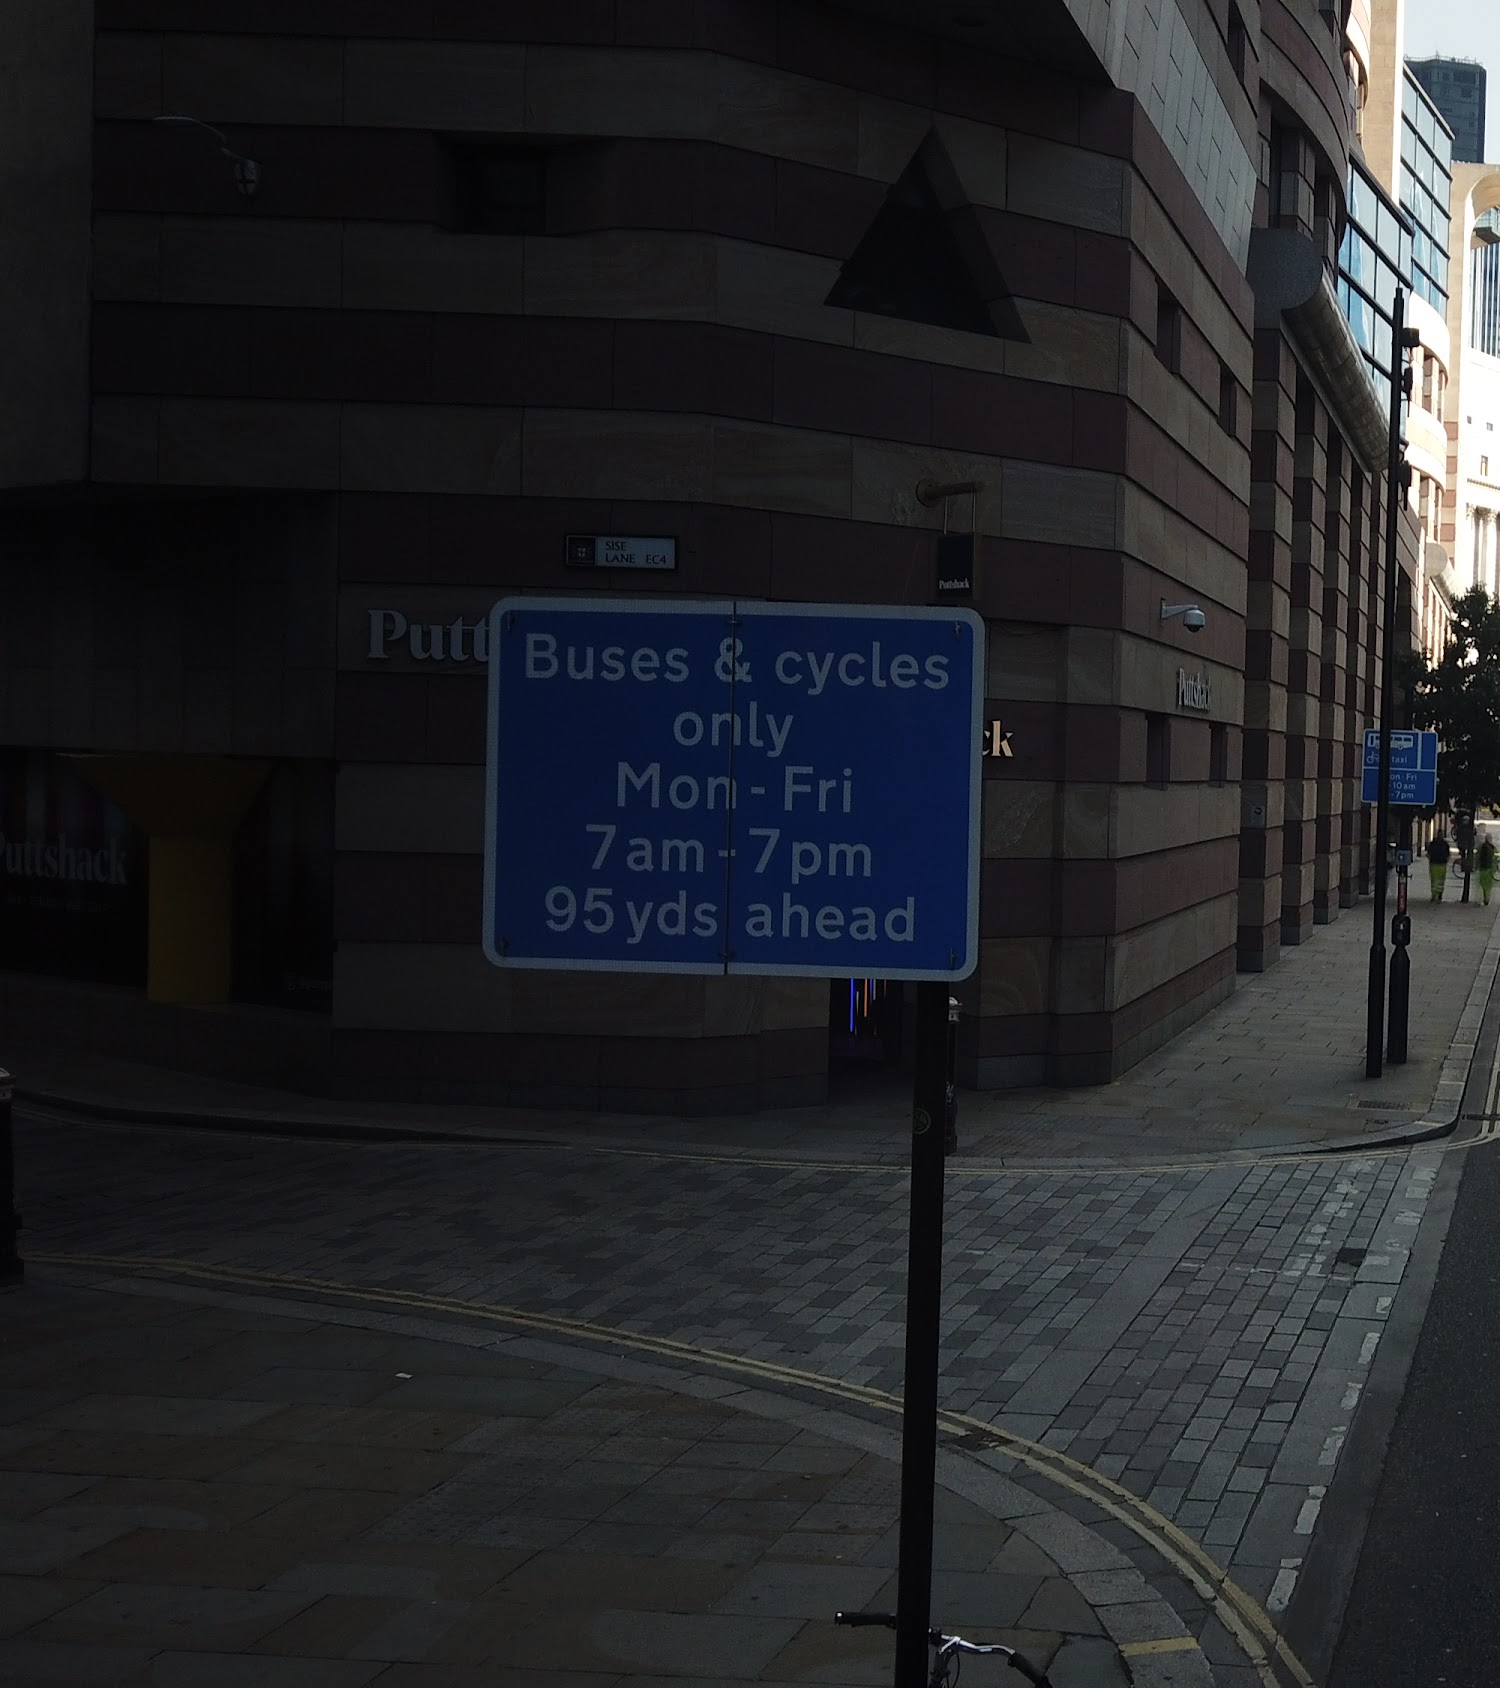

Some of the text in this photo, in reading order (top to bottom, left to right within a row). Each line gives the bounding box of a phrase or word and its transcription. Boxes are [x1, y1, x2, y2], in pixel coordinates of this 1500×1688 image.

[605, 553, 667, 565] LANE EC4
[606, 540, 627, 551] SISE
[525, 632, 950, 696] Buses & cycles
[673, 700, 795, 758] only
[1391, 755, 1408, 763] taxi
[745, 892, 916, 943] ahead
